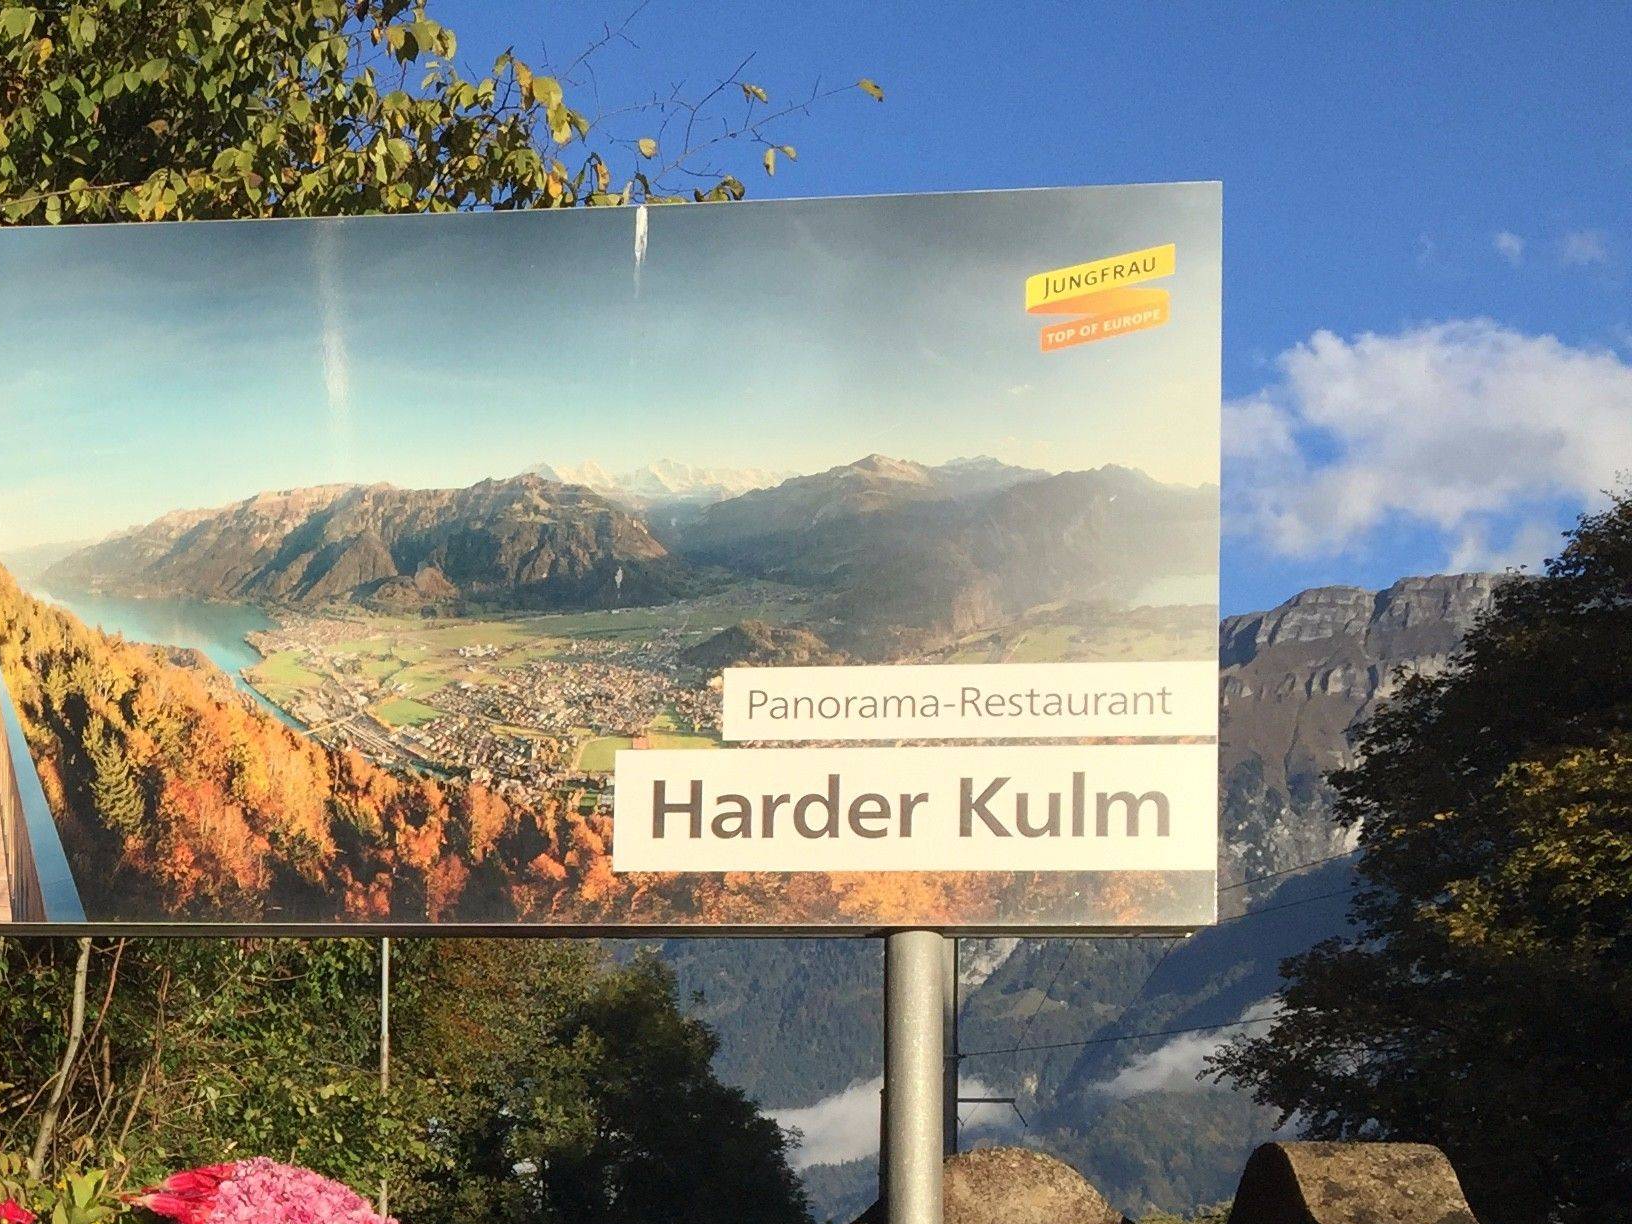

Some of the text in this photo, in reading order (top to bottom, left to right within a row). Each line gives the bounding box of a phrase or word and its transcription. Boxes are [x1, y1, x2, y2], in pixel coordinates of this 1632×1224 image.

[1043, 257, 1156, 299] JUNGFRAU
[1046, 308, 1161, 345] TOP OF EUROPE
[747, 685, 1173, 720] Panorama-Restaurant
[651, 771, 1171, 839] Harder Kulm
